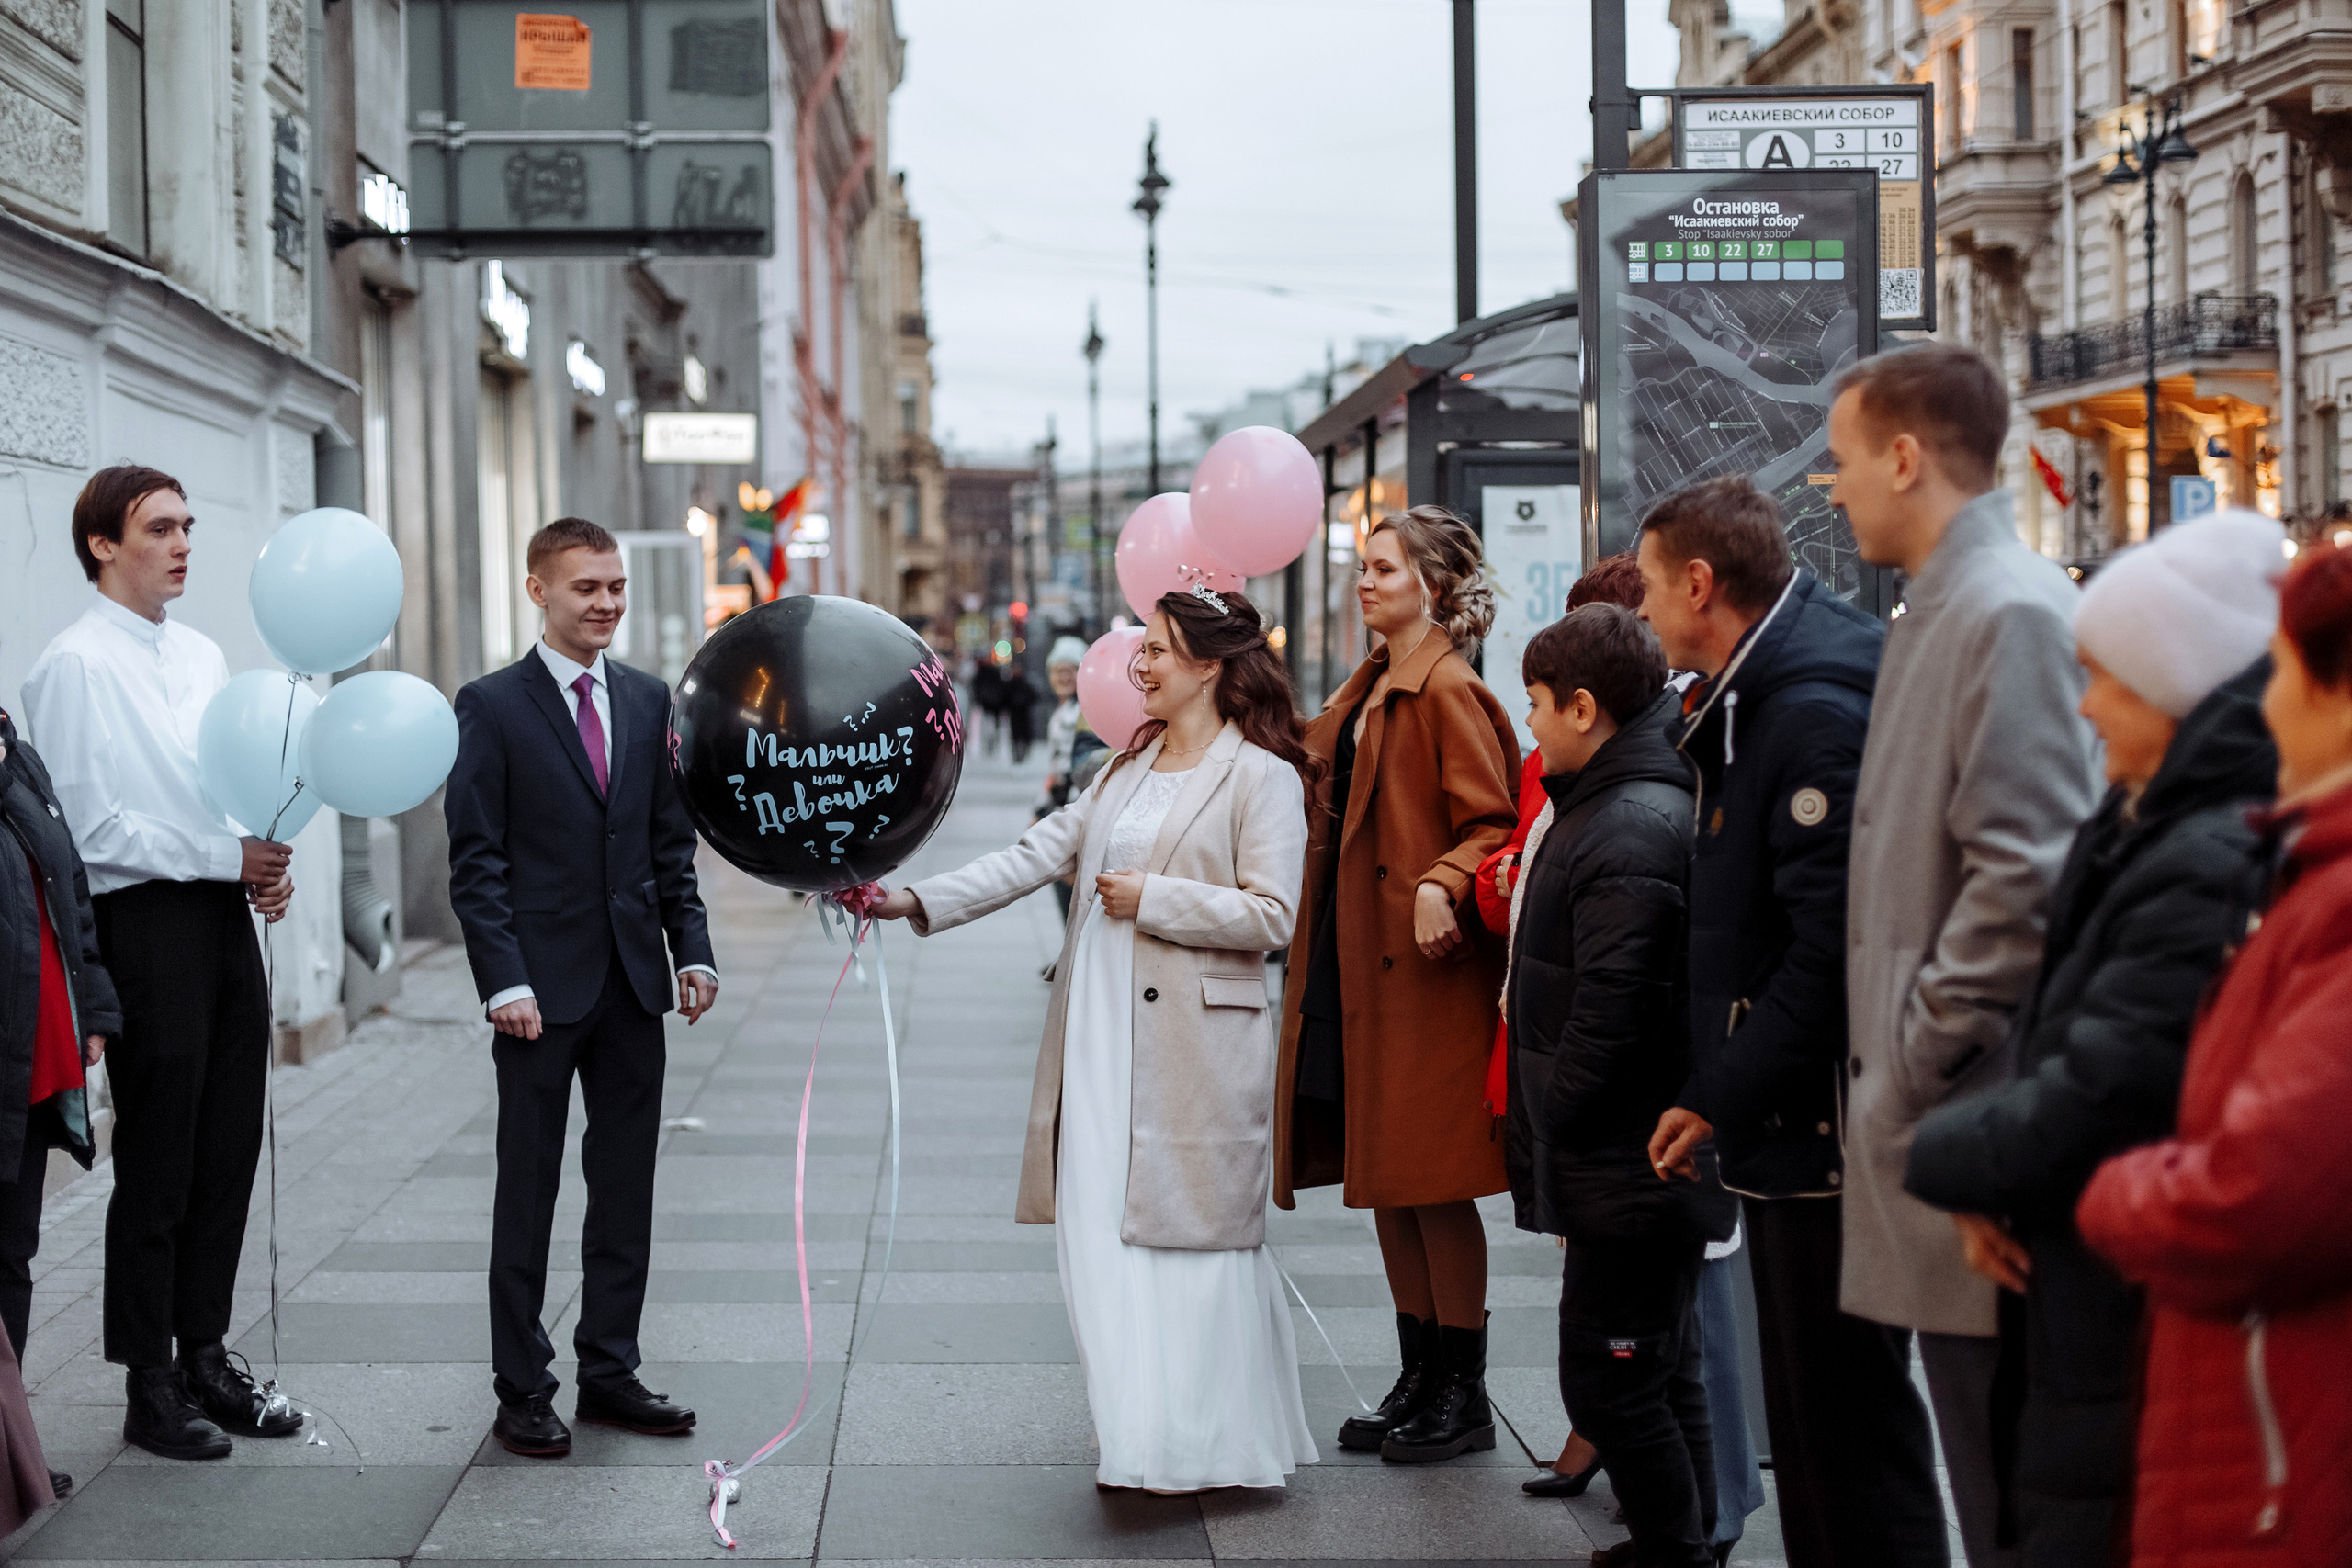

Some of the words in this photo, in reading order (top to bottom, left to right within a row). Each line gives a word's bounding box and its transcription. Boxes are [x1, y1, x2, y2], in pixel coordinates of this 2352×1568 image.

[1708, 106, 1835, 122] ИСААКИЕВСКИЙ
[1840, 107, 1894, 120] СОБОР
[1835, 132, 1845, 149] 3
[1882, 132, 1902, 148] 10
[1881, 159, 1903, 175] 27
[1692, 197, 1780, 215] Остановка
[1668, 214, 1759, 227] “Исаакиевский
[1763, 213, 1804, 230] собор”
[1679, 229, 1701, 241] Stop
[1665, 244, 1673, 257] 3
[1692, 244, 1710, 257] 10
[1724, 244, 1741, 256] 22
[1757, 243, 1774, 256] 27
[746, 726, 913, 768] Мальчик?
[812, 774, 845, 786] или
[753, 773, 899, 835] Девочка
